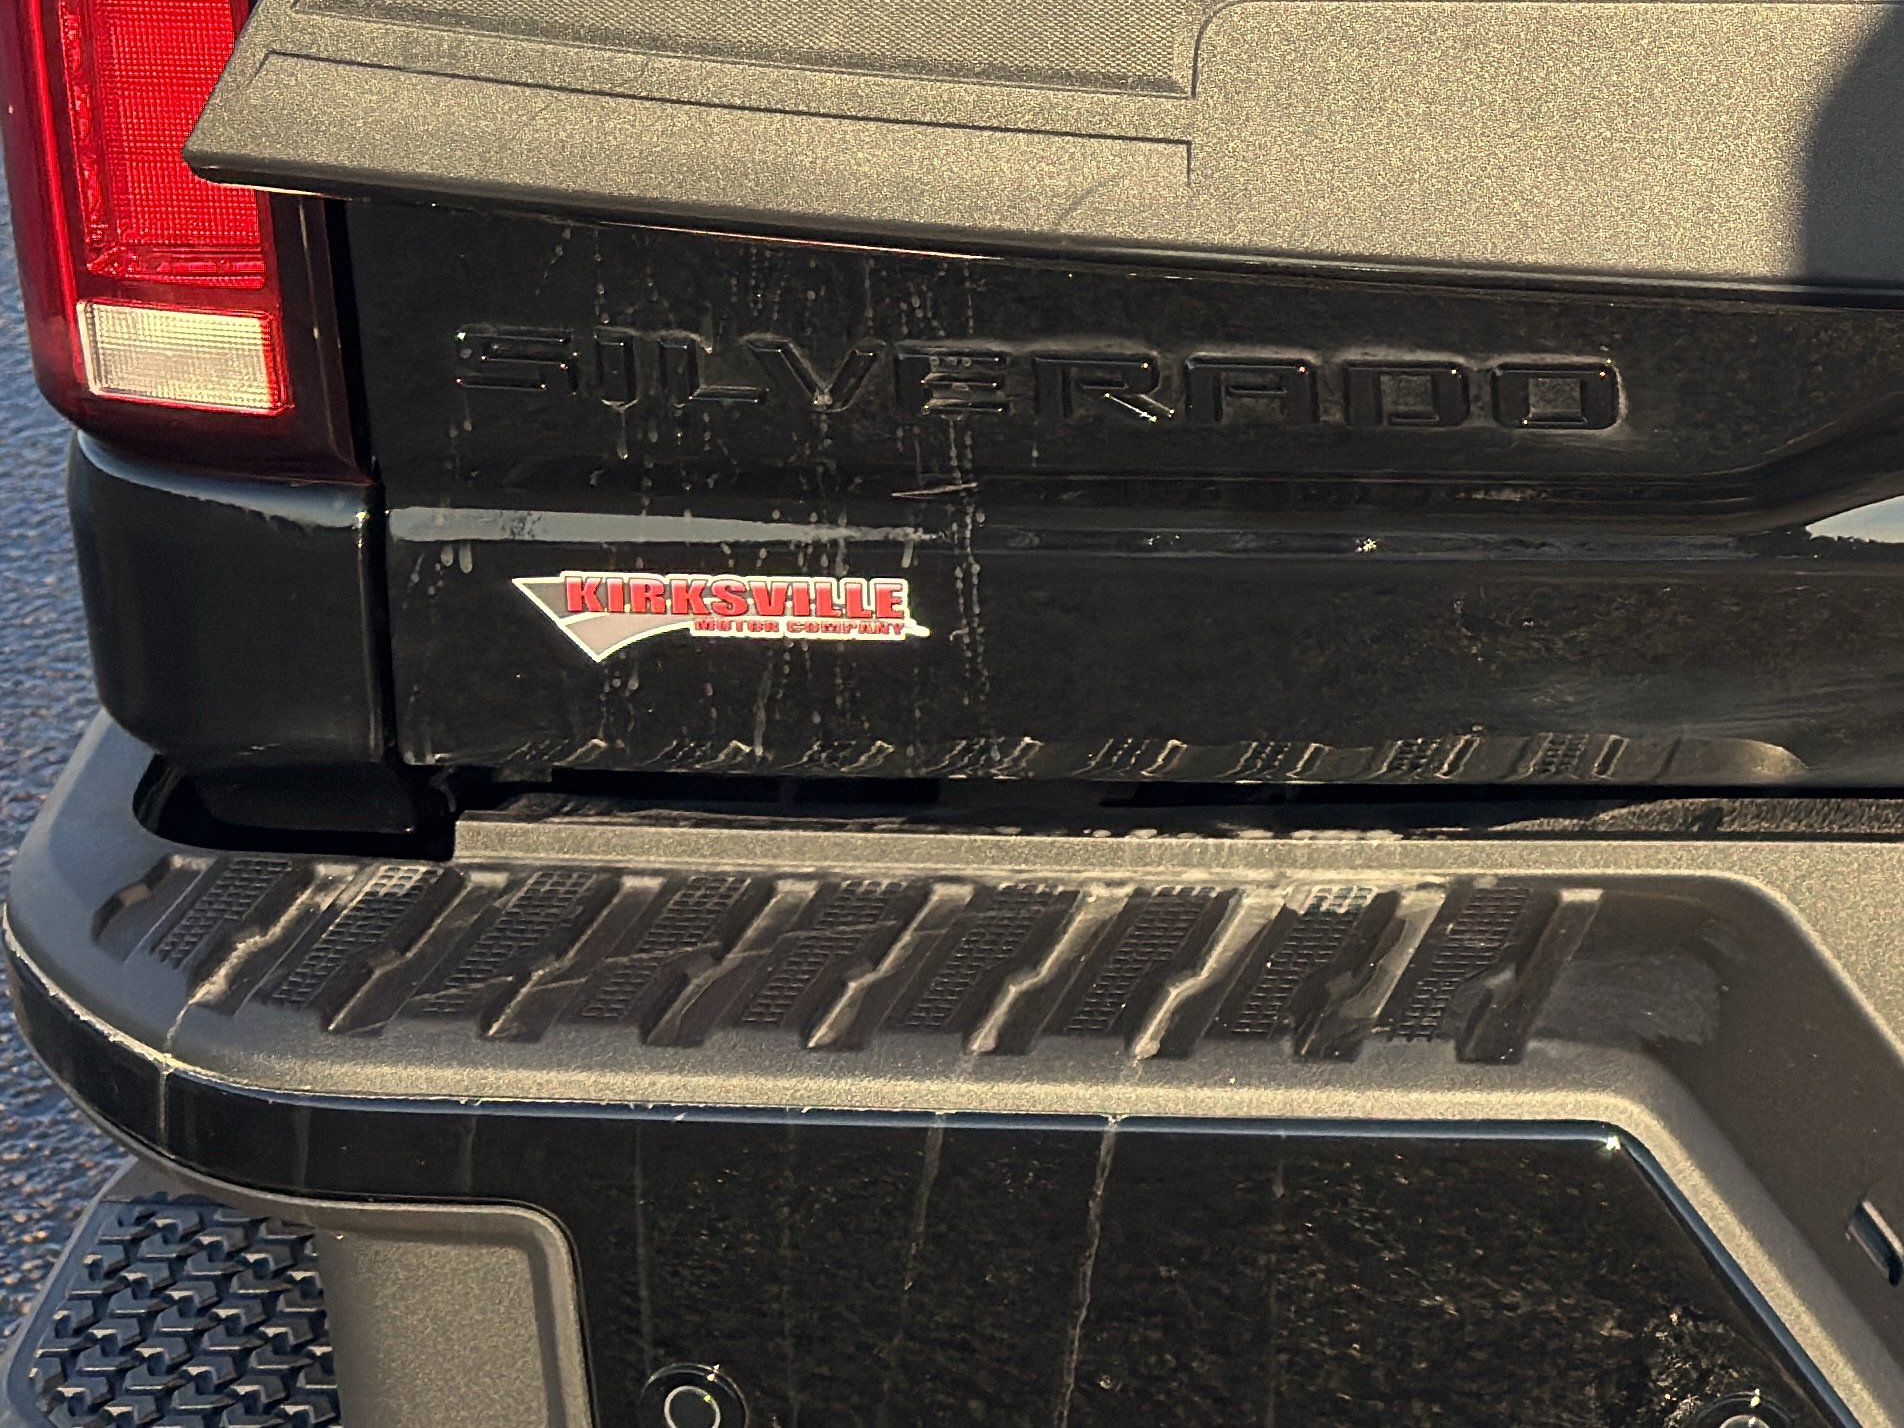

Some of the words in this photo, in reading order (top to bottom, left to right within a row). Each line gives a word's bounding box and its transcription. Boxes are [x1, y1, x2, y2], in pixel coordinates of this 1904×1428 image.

[456, 326, 1622, 429] SILVERADO
[565, 576, 906, 619] KIRKSVILLE
[694, 619, 780, 633] MOTOR
[786, 620, 905, 636] COMPANY
